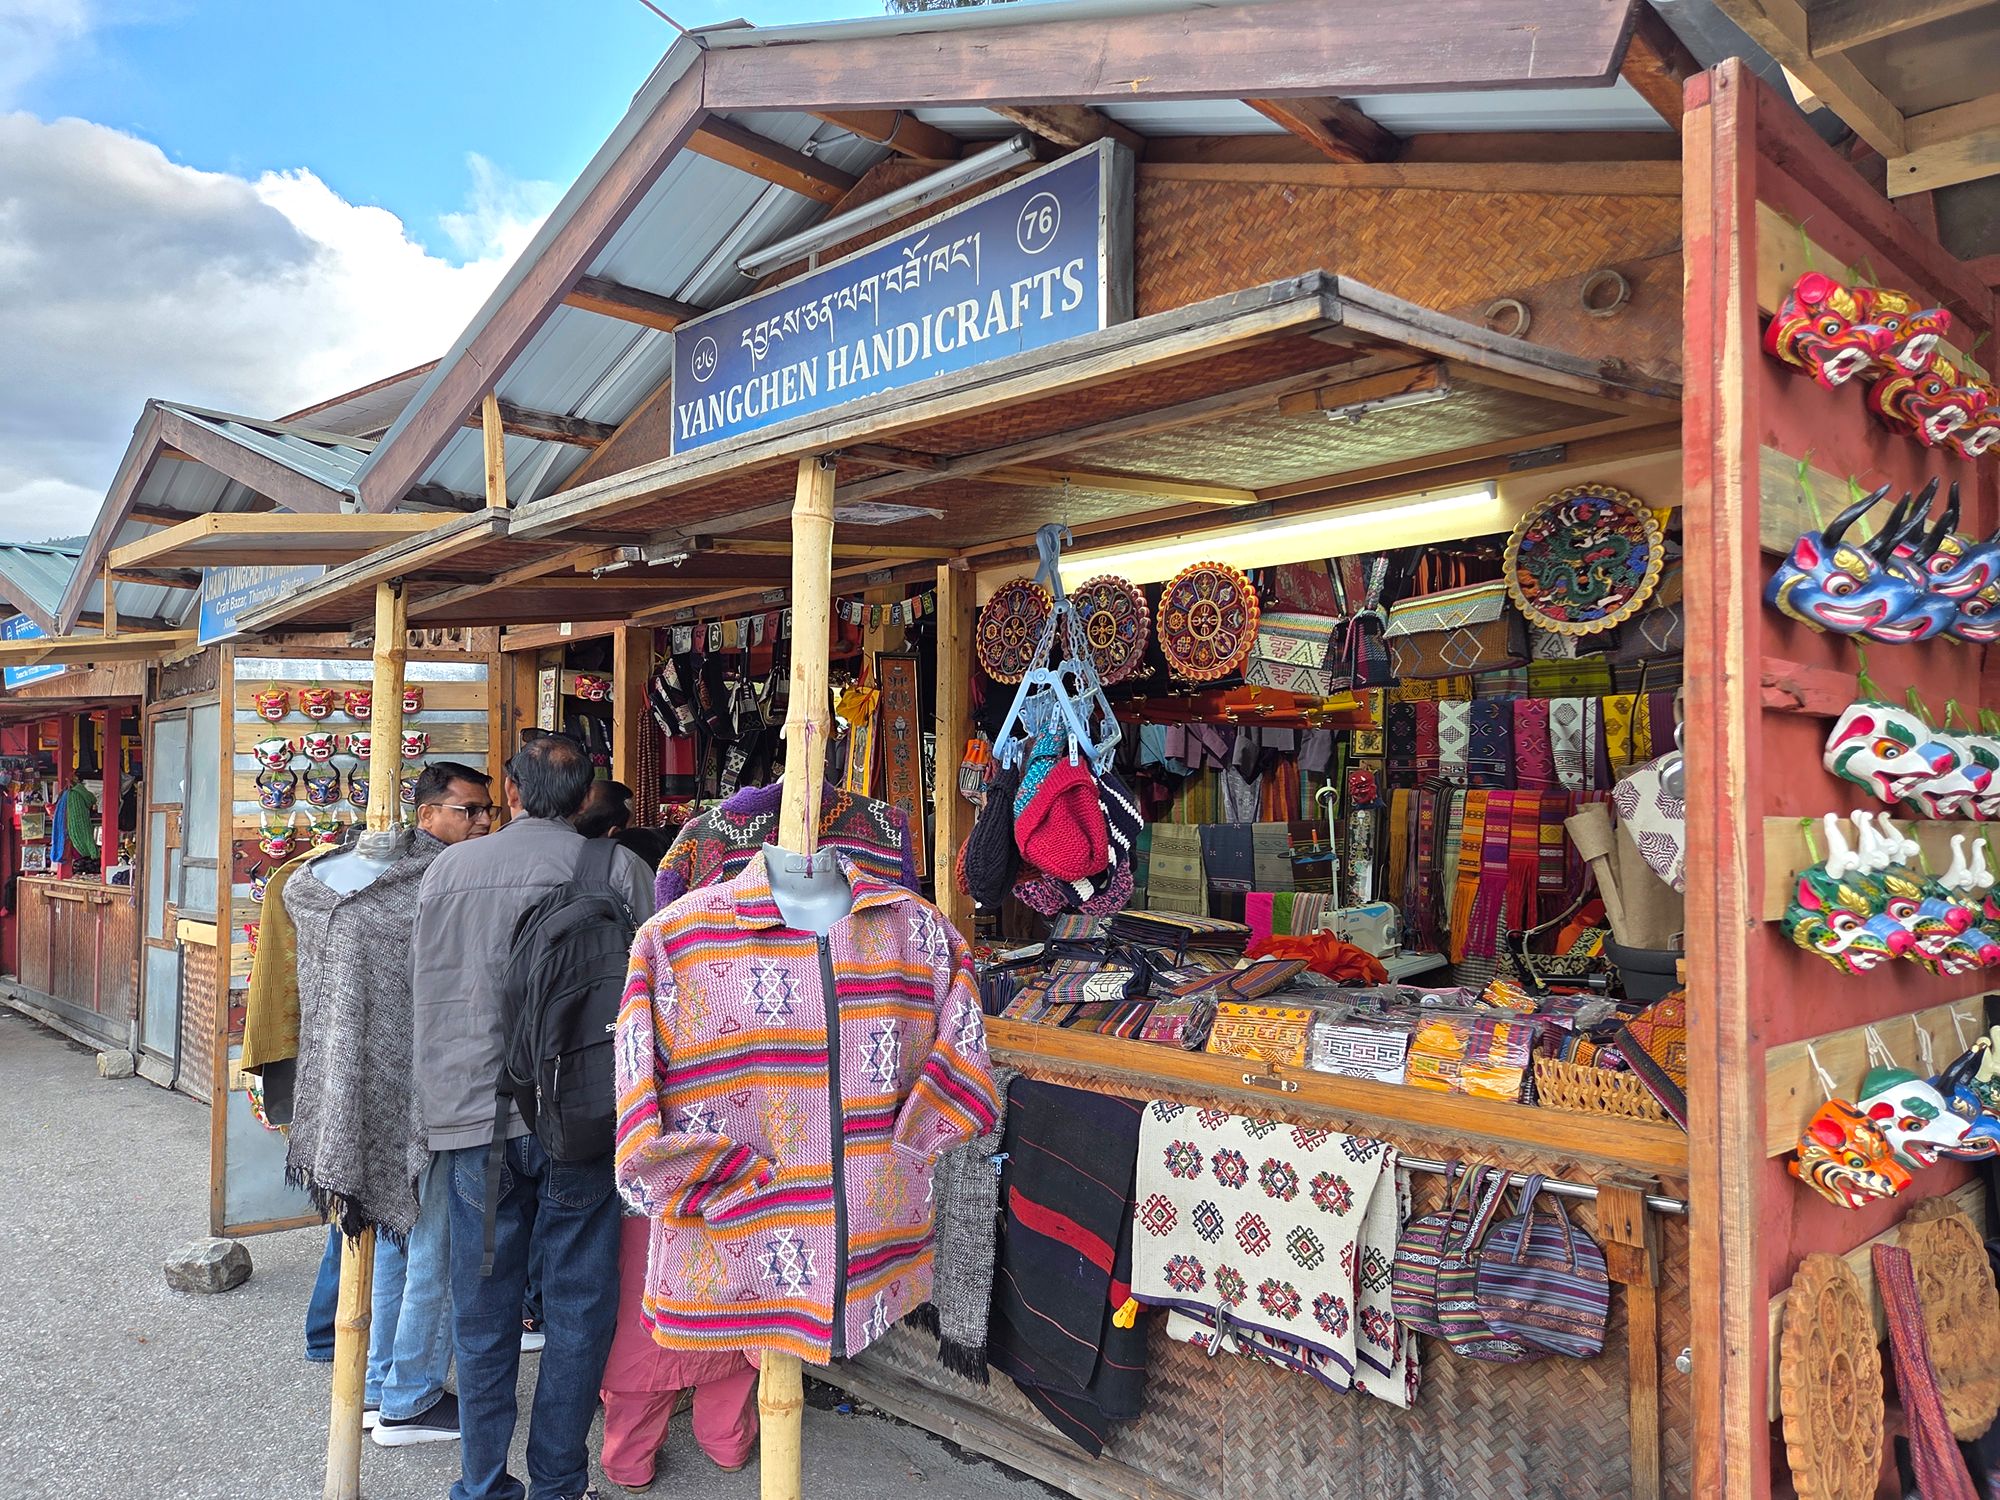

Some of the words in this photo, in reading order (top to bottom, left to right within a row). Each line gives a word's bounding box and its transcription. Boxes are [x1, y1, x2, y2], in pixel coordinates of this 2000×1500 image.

[1025, 205, 1053, 242] 76
[678, 355, 818, 440] YANGCHEN
[825, 258, 1085, 392] HANDICRAFTS
[216, 599, 230, 615] Craft
